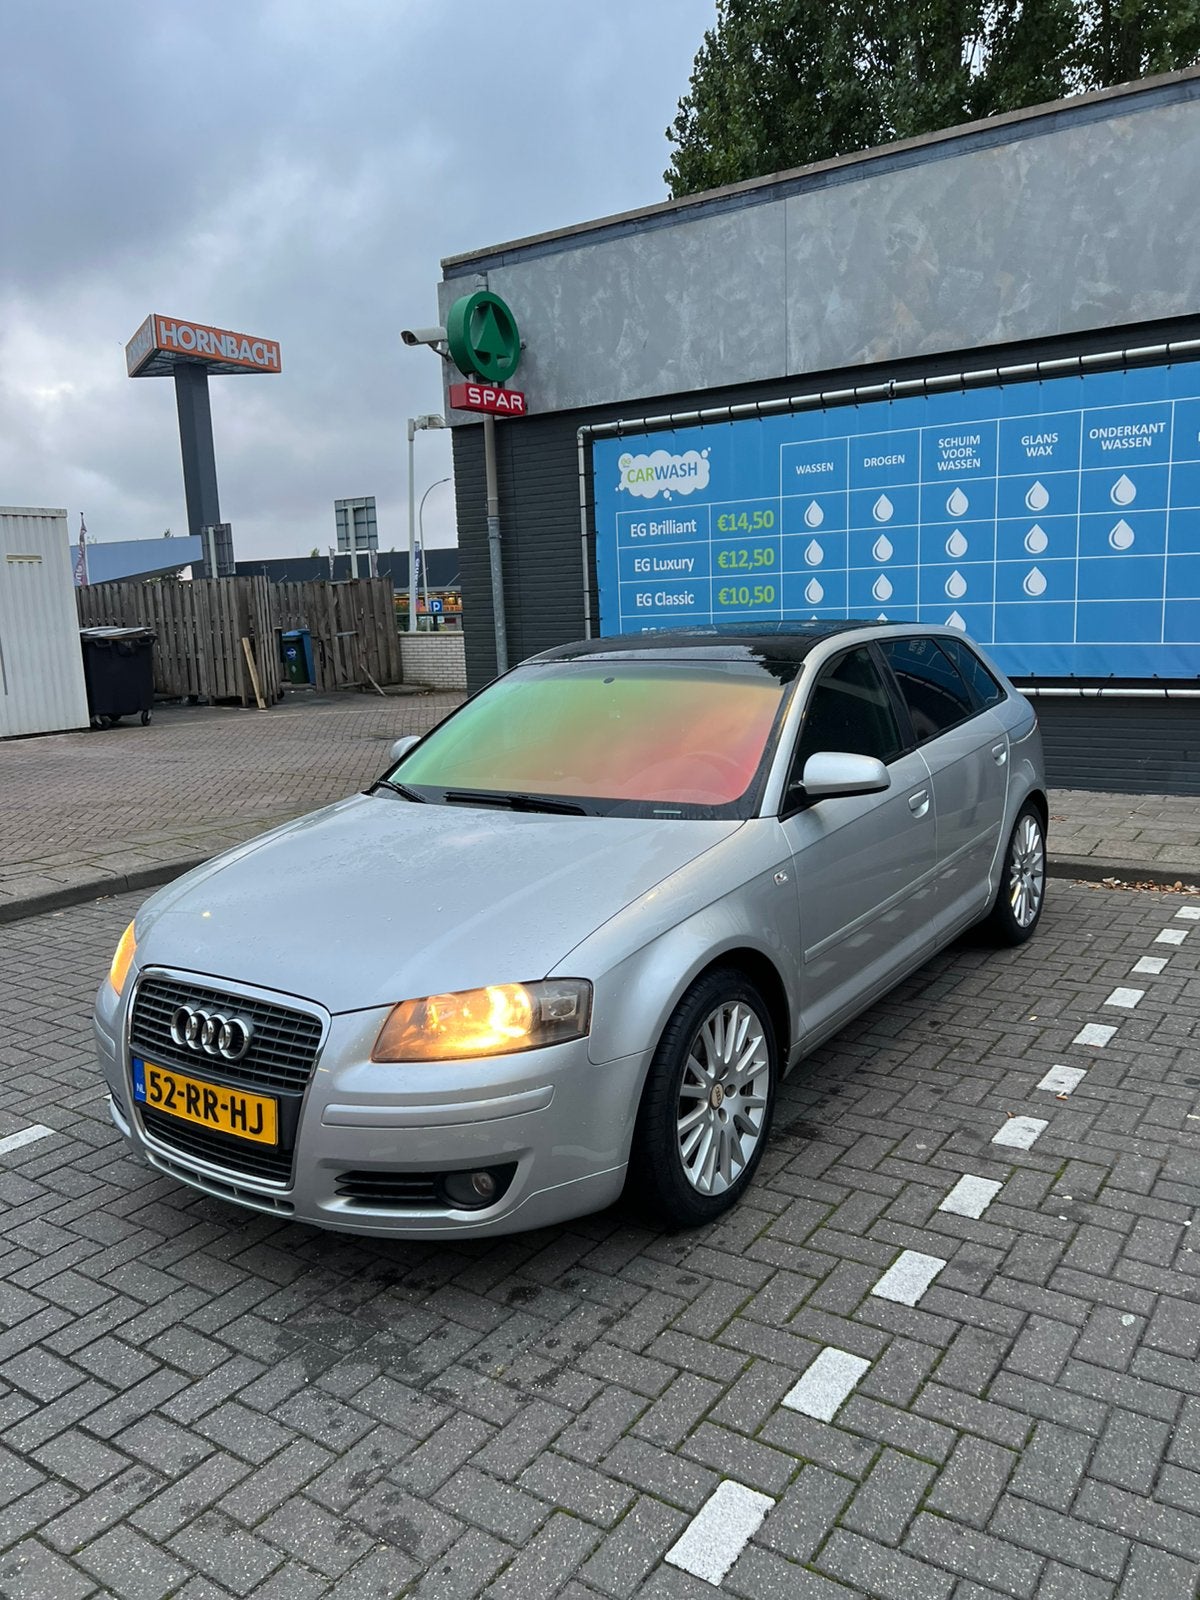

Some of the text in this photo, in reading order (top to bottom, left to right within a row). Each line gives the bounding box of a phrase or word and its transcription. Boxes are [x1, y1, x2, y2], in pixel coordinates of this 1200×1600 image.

[159, 320, 278, 368] HORNBACH
[468, 387, 523, 411] SPAR
[1089, 422, 1166, 440] ONDERKANT
[938, 434, 981, 448] SCHUIM
[1021, 432, 1058, 447] GLANS
[1101, 436, 1152, 451] WASSEN
[942, 446, 976, 460] VOOR-
[1026, 445, 1053, 458] WAX
[795, 462, 834, 475] WASSEN
[864, 454, 906, 468] DROGEN
[937, 457, 981, 472] WASSEN
[627, 461, 698, 485] CARWASH
[630, 510, 775, 538] EG Brilliant €14,50
[634, 547, 775, 573] EG Luxury €12,50
[636, 586, 775, 608] EG Classic €10,50
[432, 601, 441, 612] P
[136, 1082, 145, 1094] NL
[149, 1070, 263, 1135] 52-RR-HJ
